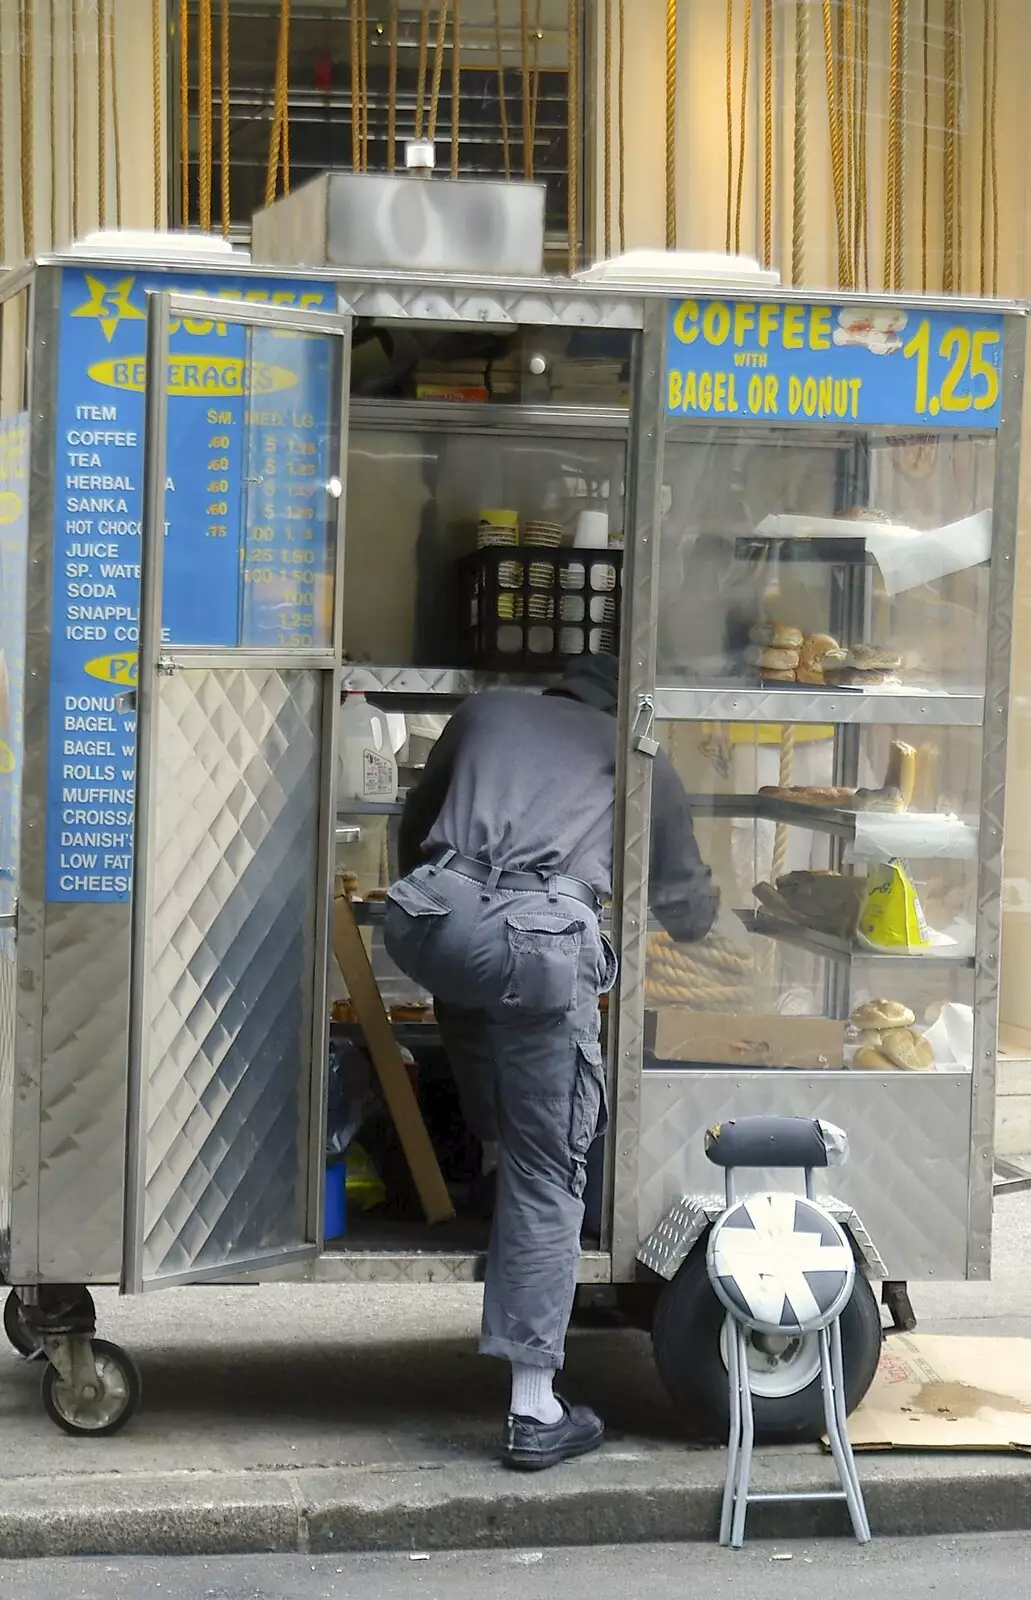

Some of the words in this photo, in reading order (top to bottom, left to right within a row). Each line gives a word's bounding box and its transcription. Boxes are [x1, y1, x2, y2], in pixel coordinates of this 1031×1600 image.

[98, 292, 121, 319] 5
[673, 299, 833, 350] COFFEE
[904, 318, 1000, 416] 1.25
[734, 352, 767, 368] WITH
[112, 362, 274, 389] BEERAGES
[668, 371, 739, 413] BAGEL
[749, 373, 779, 414] OR
[788, 376, 862, 418] DONUT
[76, 406, 117, 420] ITEM
[67, 430, 137, 446] COFFEE
[68, 453, 102, 467] TEA
[66, 475, 135, 491] HERBAL
[66, 497, 128, 513] SANKA
[66, 519, 94, 534] HOT
[65, 543, 119, 558] JUICE
[65, 563, 93, 578] SP.
[67, 583, 117, 598] SODA
[67, 605, 140, 621] SNAPPL
[66, 626, 108, 640] ICED
[64, 716, 117, 732] BAGEL
[63, 740, 116, 756] BAGEL
[63, 765, 115, 781] ROLLS
[63, 788, 135, 805] MUFFINS
[60, 853, 97, 869] LOW
[104, 854, 131, 869] FAT
